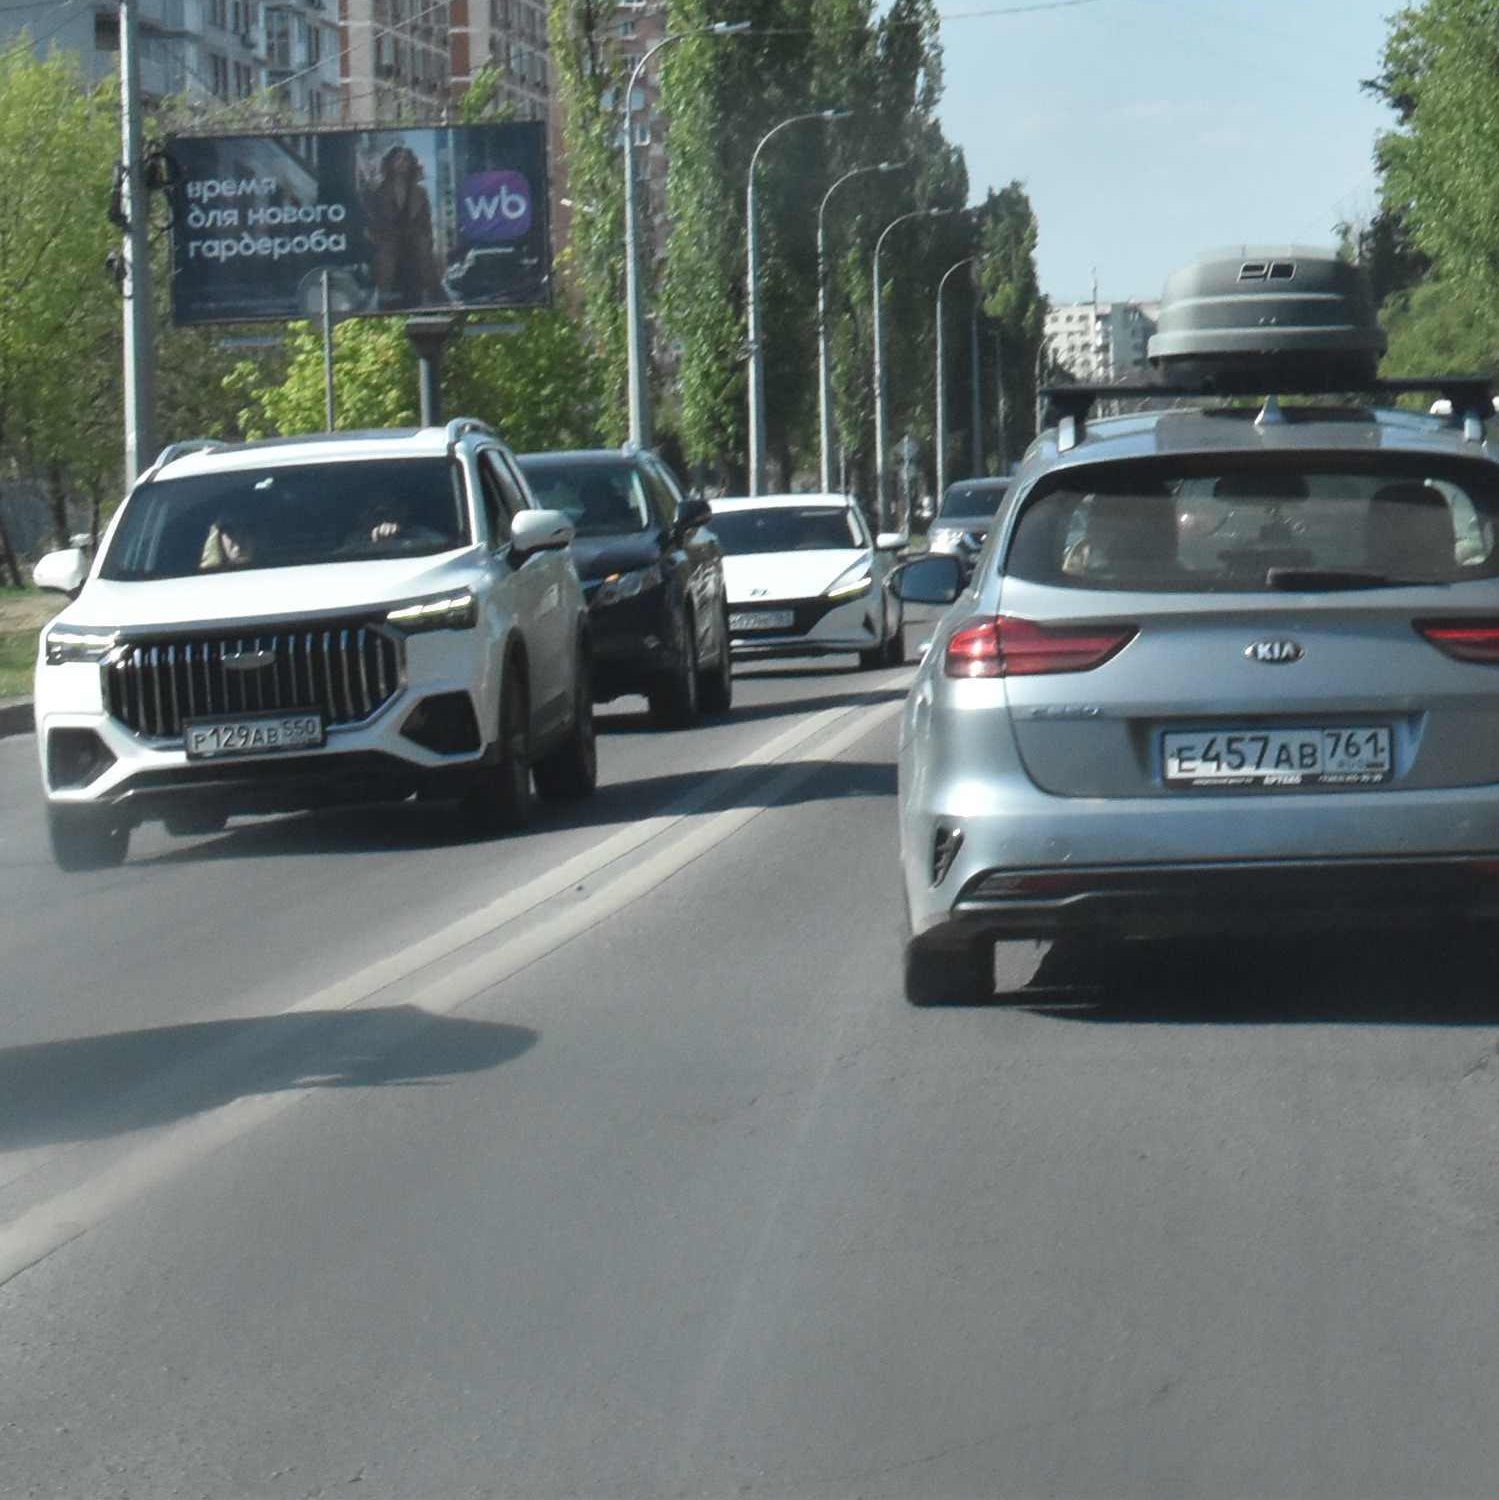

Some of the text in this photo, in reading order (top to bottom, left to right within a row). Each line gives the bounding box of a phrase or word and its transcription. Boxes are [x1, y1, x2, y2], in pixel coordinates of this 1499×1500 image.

[187, 176, 278, 204] время
[464, 185, 527, 220] wb
[187, 203, 346, 229] для нового
[188, 228, 347, 263] гардероба
[1256, 640, 1299, 661] KIA
